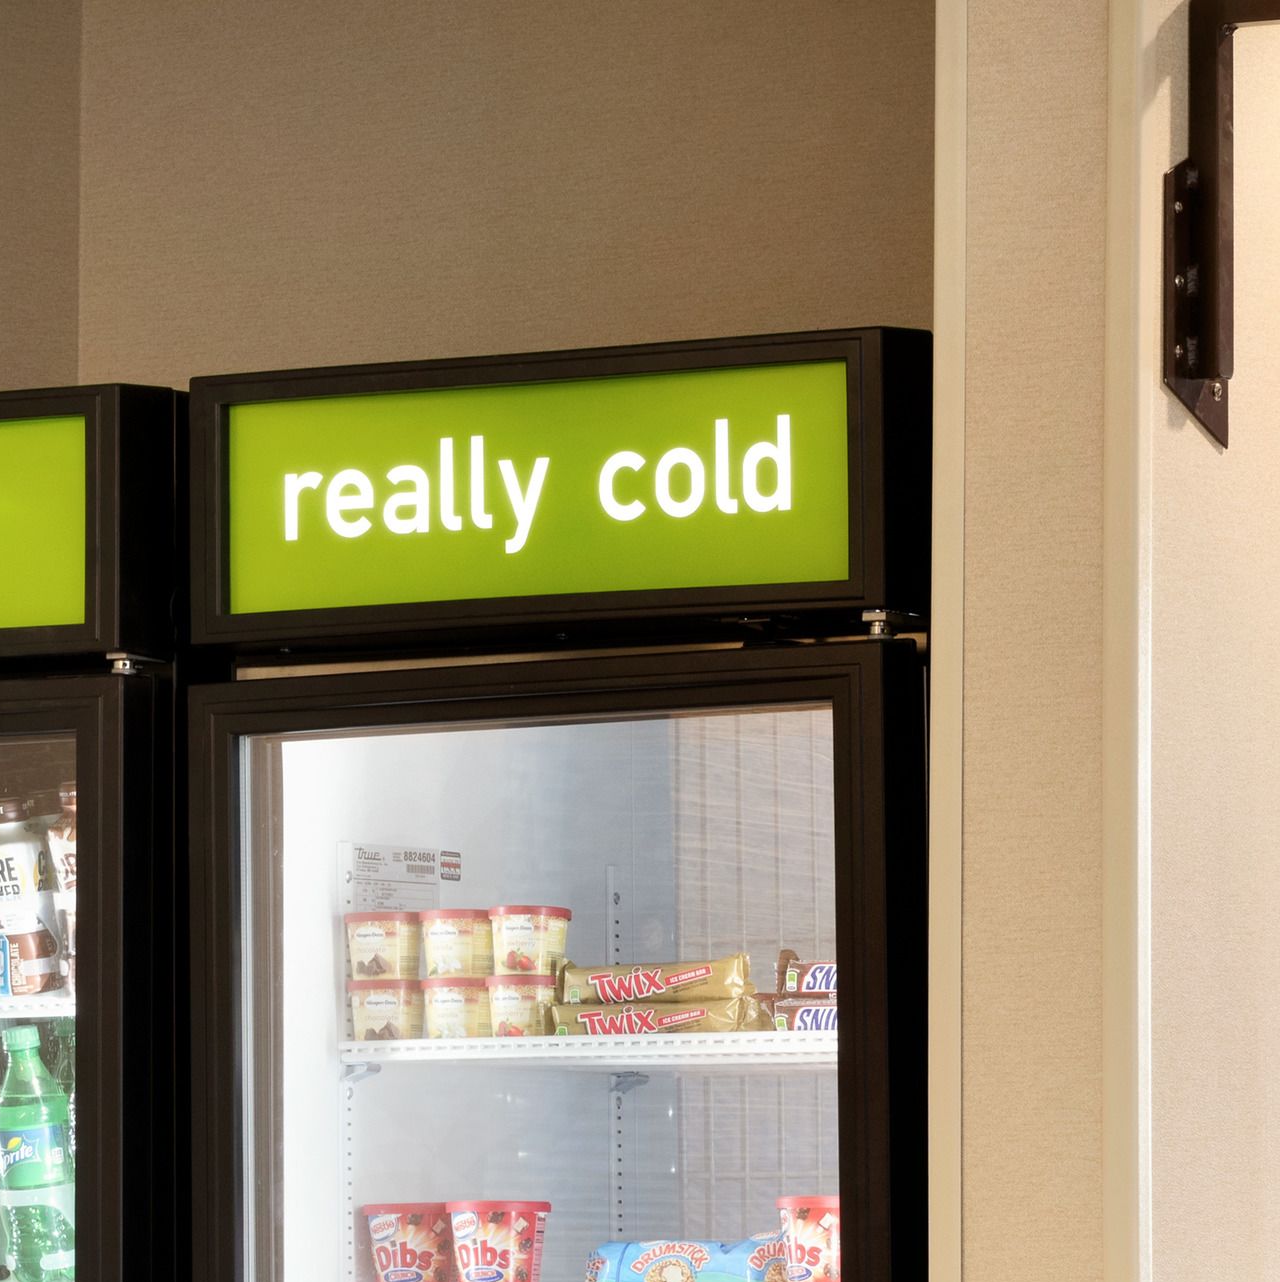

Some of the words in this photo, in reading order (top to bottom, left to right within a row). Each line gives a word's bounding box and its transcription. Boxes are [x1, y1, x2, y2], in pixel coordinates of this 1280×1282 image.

[282, 434, 551, 555] really
[597, 413, 793, 523] cold
[375, 1240, 435, 1272] Dibs
[458, 1239, 511, 1270] Dibs
[630, 1242, 711, 1274] DRUMSTICK
[389, 1271, 417, 1281] CRUNCH
